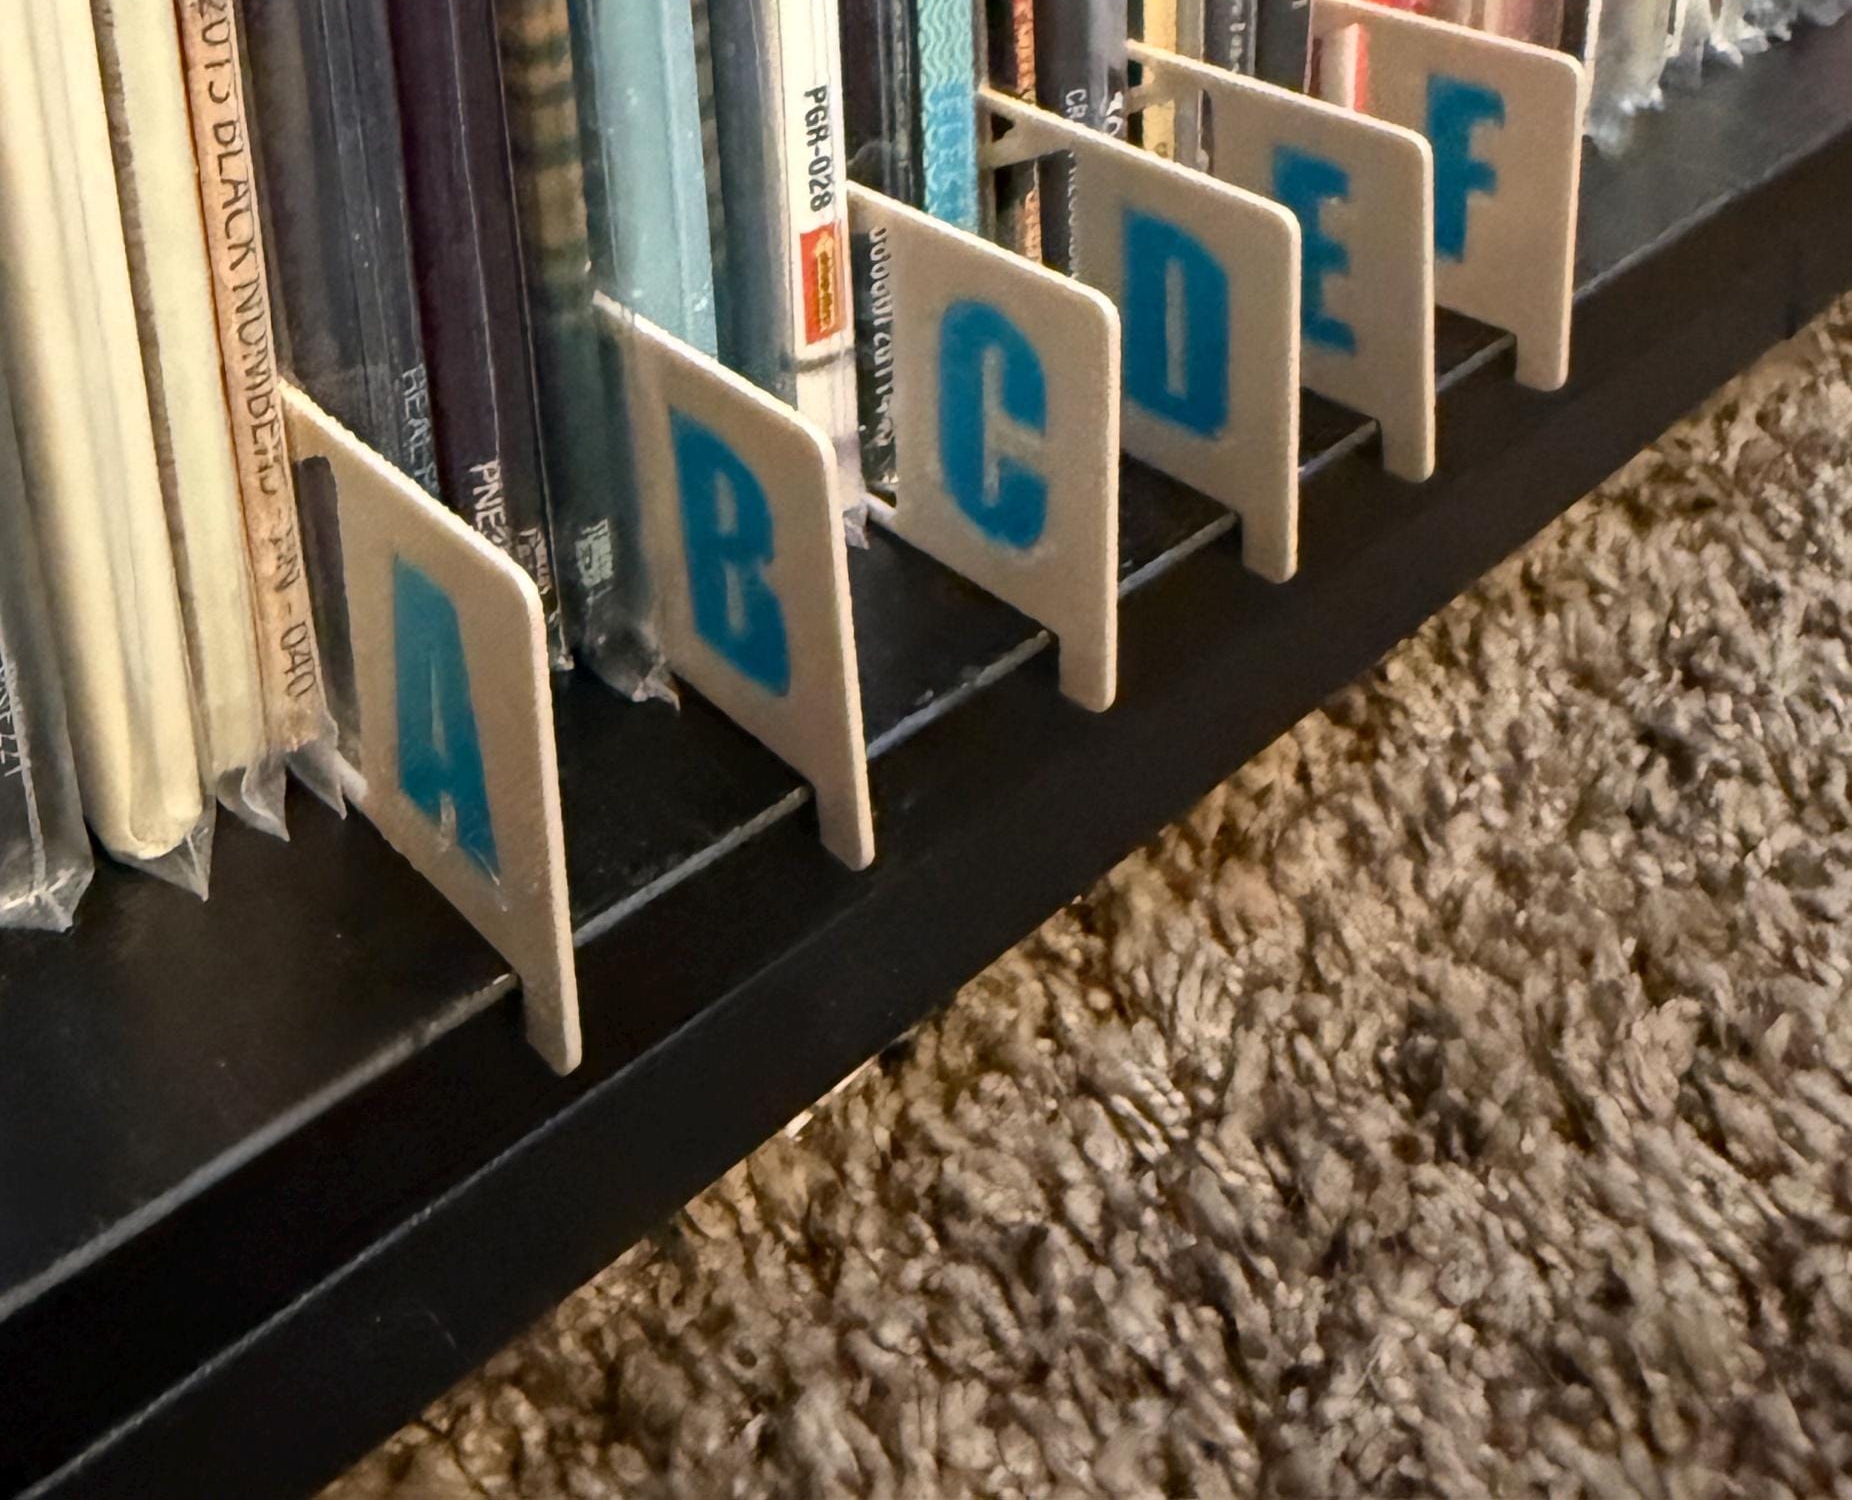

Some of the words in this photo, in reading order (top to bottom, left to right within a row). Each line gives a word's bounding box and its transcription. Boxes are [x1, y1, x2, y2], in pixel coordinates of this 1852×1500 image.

[212, 119, 257, 272] BLACK
[1271, 144, 1357, 356] E
[1425, 72, 1506, 264] F
[939, 298, 1048, 552] C
[1123, 206, 1229, 441] D
[667, 405, 792, 699] B
[393, 552, 501, 888] A
